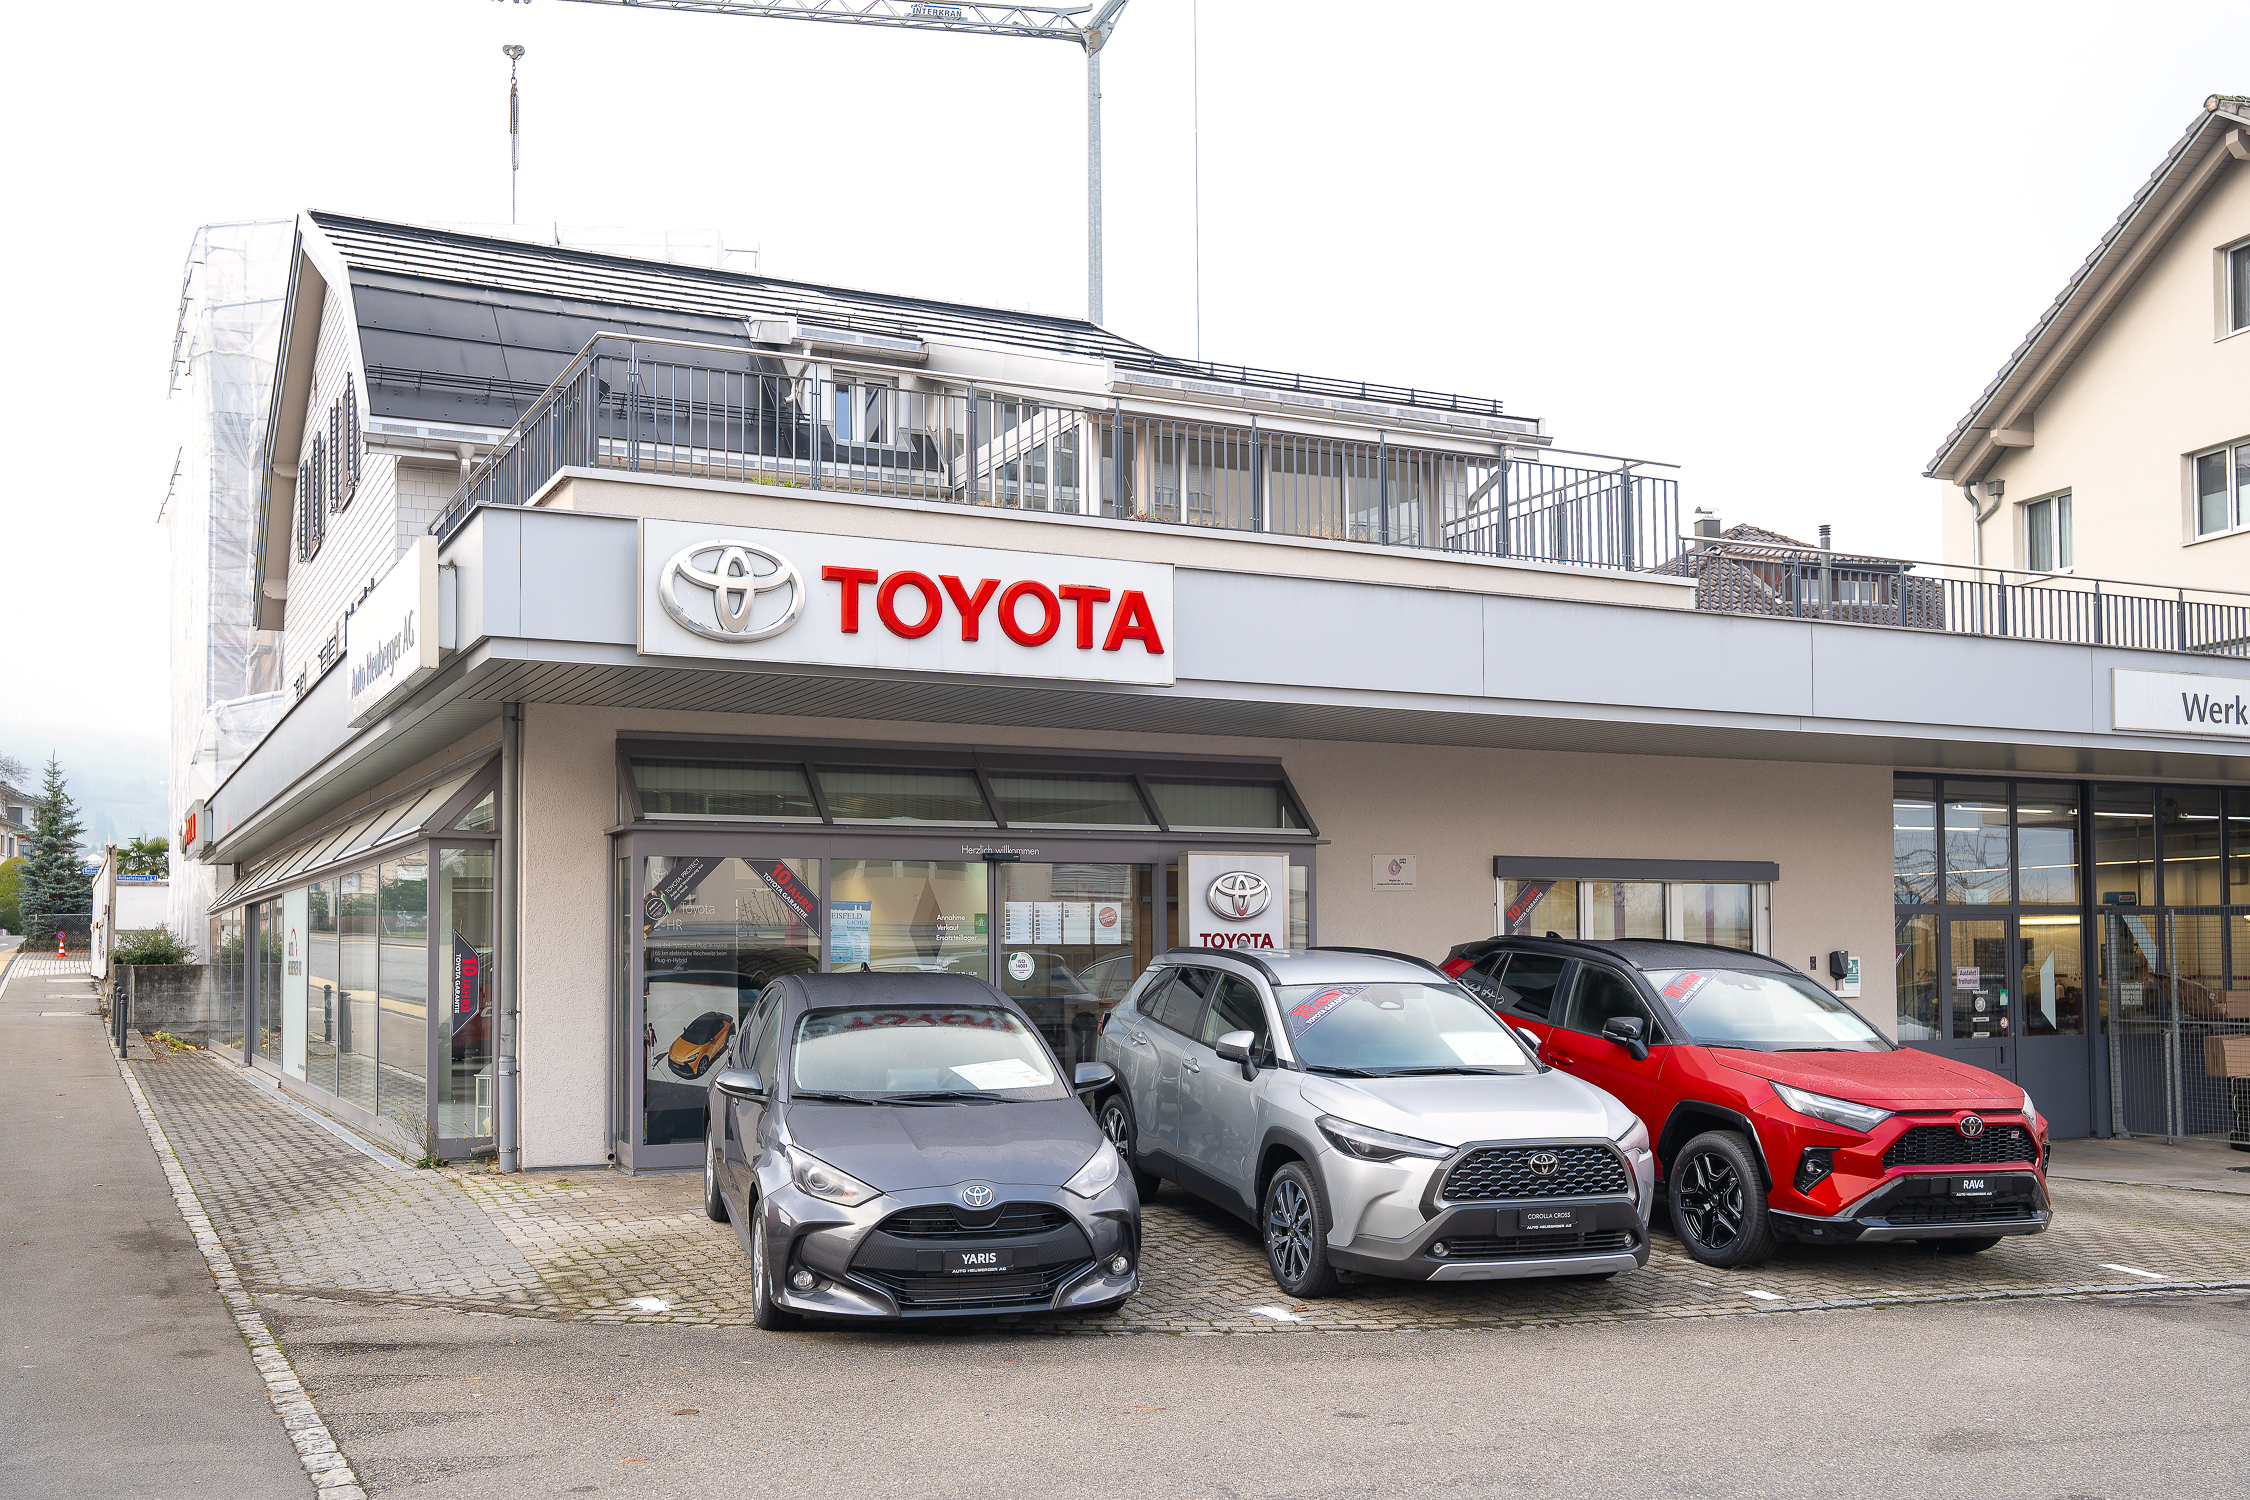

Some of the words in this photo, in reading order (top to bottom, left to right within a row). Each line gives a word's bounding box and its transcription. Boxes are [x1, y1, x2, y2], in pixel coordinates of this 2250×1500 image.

[912, 7, 962, 17] INTERKRAN
[821, 565, 1165, 654] TOYOTA
[351, 662, 366, 700] Auto
[366, 631, 402, 686] Heuberger
[403, 609, 415, 654] AG
[2181, 692, 2250, 725] Werk
[961, 844, 993, 855] Herzlich
[994, 844, 1040, 856] willkommen
[664, 877, 682, 894] TOYOTA
[681, 858, 700, 878] PROTECT
[763, 872, 783, 895] TOYOTA
[782, 892, 809, 920] GARANTIE
[771, 863, 791, 885] 10
[783, 882, 814, 913] JAHRE
[681, 901, 715, 918] Toyota
[1507, 904, 1521, 922] 10
[1520, 886, 1540, 911] JAHRE
[1513, 911, 1527, 928] TOYOTA
[1525, 891, 1544, 913] GARANTIE
[831, 912, 863, 920] EISFELD
[936, 913, 966, 921] Annahme
[936, 923, 960, 931] Verkauf
[936, 933, 978, 943] Ersatzteillager
[1200, 933, 1274, 949] TOYOTA
[462, 956, 478, 976] 10
[461, 977, 472, 1013] JAHRE
[1663, 985, 1685, 999] 10
[1678, 973, 1700, 990] JAHRE
[1292, 1004, 1316, 1019] 10
[1312, 989, 1341, 1010] JAHRE
[1963, 1179, 1985, 1190] RAV4
[1553, 1211, 1571, 1219] CROSS
[961, 1252, 997, 1265] YARIS
